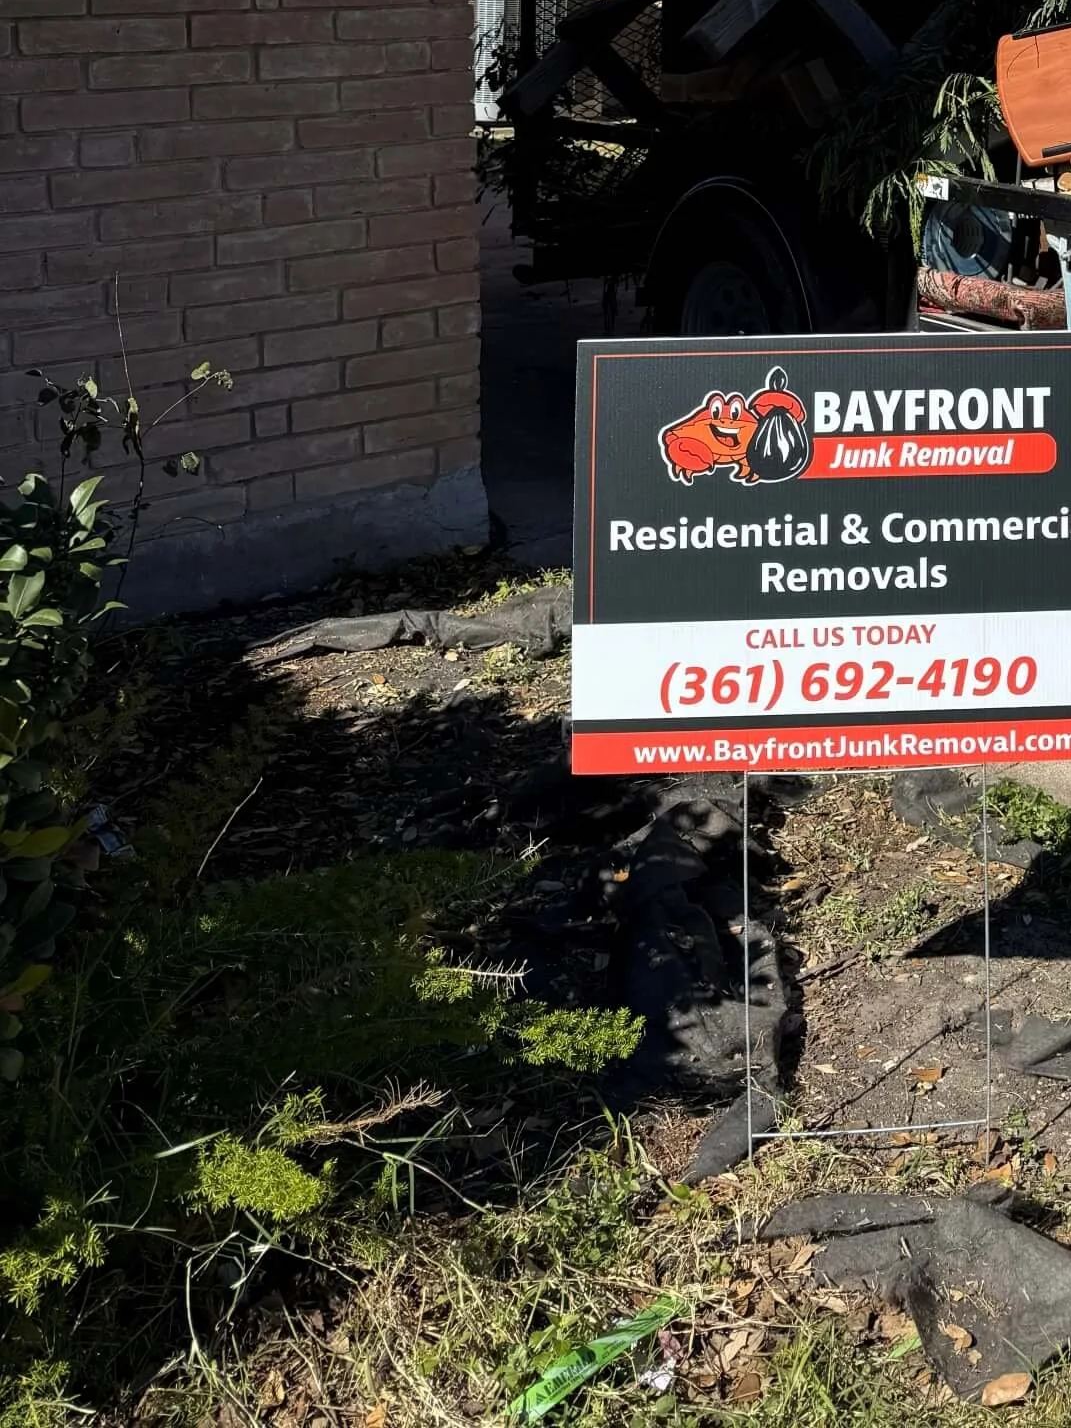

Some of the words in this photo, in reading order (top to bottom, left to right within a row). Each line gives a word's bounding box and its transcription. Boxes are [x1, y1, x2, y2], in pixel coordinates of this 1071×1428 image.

[814, 387, 1051, 432] BAYFRONT
[829, 441, 894, 469] Junk
[899, 438, 1015, 468] Removal
[609, 513, 829, 552] Residential
[840, 514, 871, 545] &
[761, 557, 948, 593] Removals
[745, 629, 805, 649] CALL
[813, 628, 845, 647] US
[853, 624, 937, 646] TODAY
[660, 660, 785, 713] (361)
[801, 656, 1038, 701] 692-4190
